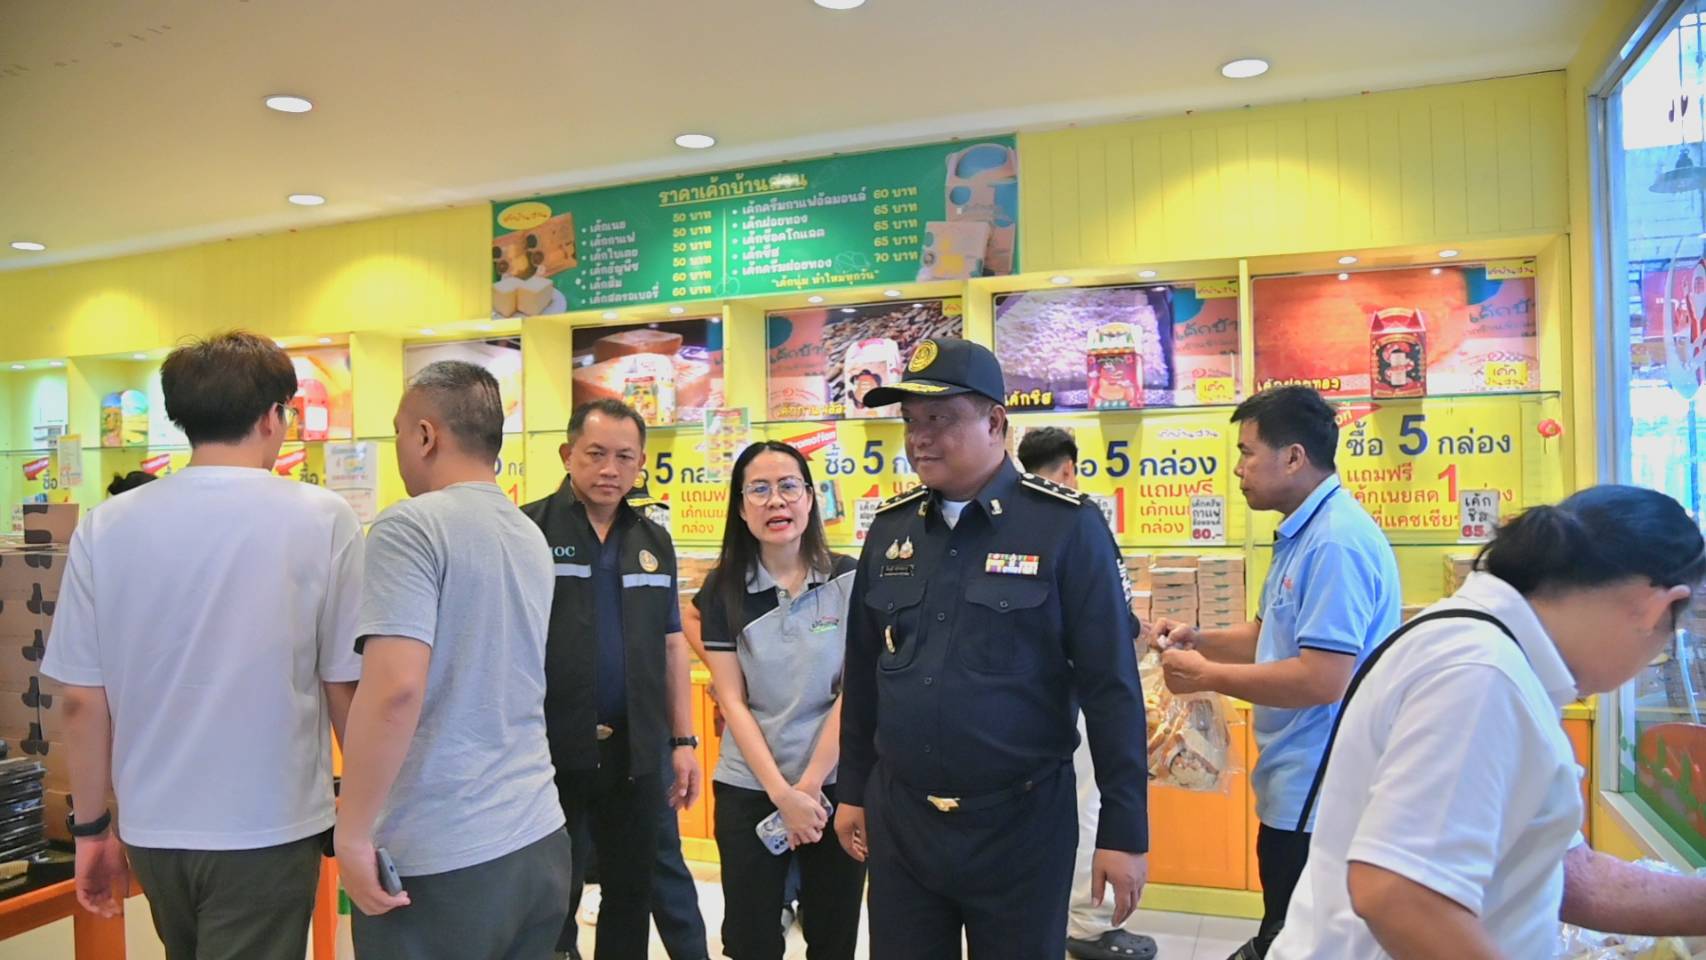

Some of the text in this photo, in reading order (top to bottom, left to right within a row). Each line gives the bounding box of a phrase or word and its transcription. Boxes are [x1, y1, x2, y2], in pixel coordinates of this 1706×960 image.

[873, 189, 889, 200] 60
[892, 186, 917, 198] บาท
[873, 205, 889, 215] 65
[892, 202, 918, 214] บาท
[672, 213, 687, 223] 50
[689, 210, 713, 221] บาท
[873, 220, 889, 231] 65
[893, 218, 918, 230] บาท
[672, 227, 687, 238] 50
[689, 225, 713, 237] บาท
[672, 242, 687, 253] 50
[689, 240, 713, 252] บาท
[873, 236, 889, 247] 65
[893, 234, 918, 246] บาท
[672, 257, 687, 268] 50
[689, 255, 713, 267] บาท
[873, 252, 889, 263] 70
[893, 250, 918, 262] บาท
[672, 272, 687, 283] 60
[689, 270, 713, 282] บาท
[672, 287, 687, 298] 60
[689, 285, 713, 297] บาท
[1398, 414, 1429, 456] 5
[1438, 428, 1512, 455] กล่อง
[863, 440, 885, 475] 5
[1106, 440, 1131, 478] 5
[1139, 449, 1218, 477] กล่อง
[655, 452, 674, 485] 5
[1140, 477, 1214, 498] แถมฟรี
[1346, 462, 1413, 483] แถมฟรี
[1437, 464, 1457, 503] 1
[681, 488, 728, 503] แถมฟ
[1354, 484, 1440, 504] ค้กเนยสด
[1464, 492, 1492, 508] เค้ก
[681, 521, 715, 534] กล่อง
[1140, 516, 1185, 534] กล่อง
